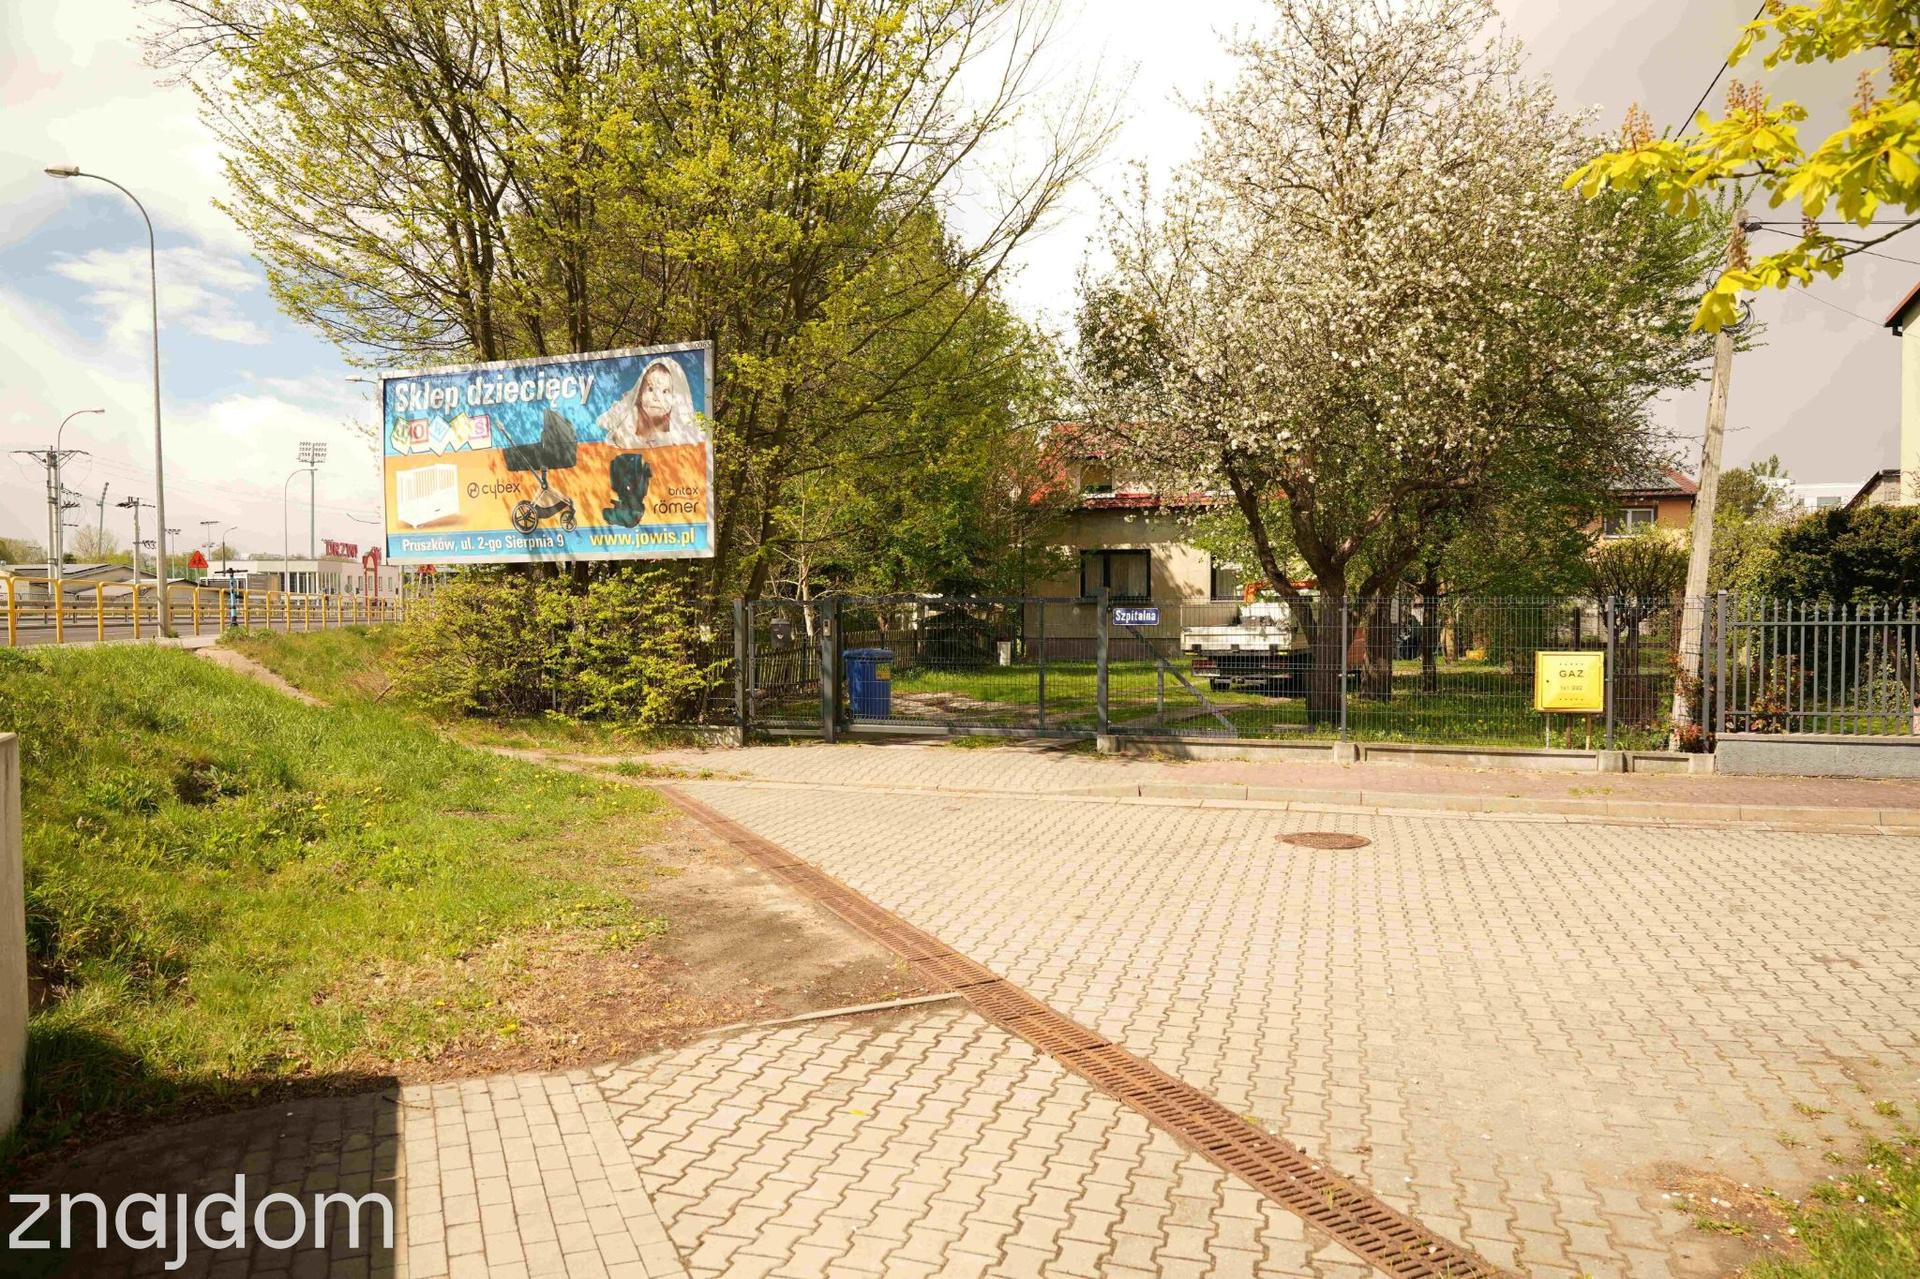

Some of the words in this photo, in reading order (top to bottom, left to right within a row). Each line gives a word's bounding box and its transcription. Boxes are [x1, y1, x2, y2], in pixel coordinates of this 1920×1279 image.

[395, 382, 460, 415] Sklep
[467, 371, 595, 407] dziecięcy
[481, 479, 521, 500] cybex
[668, 486, 699, 496] britax
[653, 500, 699, 514] römer
[402, 539, 457, 552] Pruszków,
[461, 538, 474, 550] ul.
[477, 536, 502, 552] 2-go
[505, 534, 554, 550] Sierpnia
[557, 533, 565, 547] 9
[590, 527, 696, 548] www.jowis.pl
[1115, 610, 1157, 624] Szpitalna
[1559, 669, 1584, 678] GAZ
